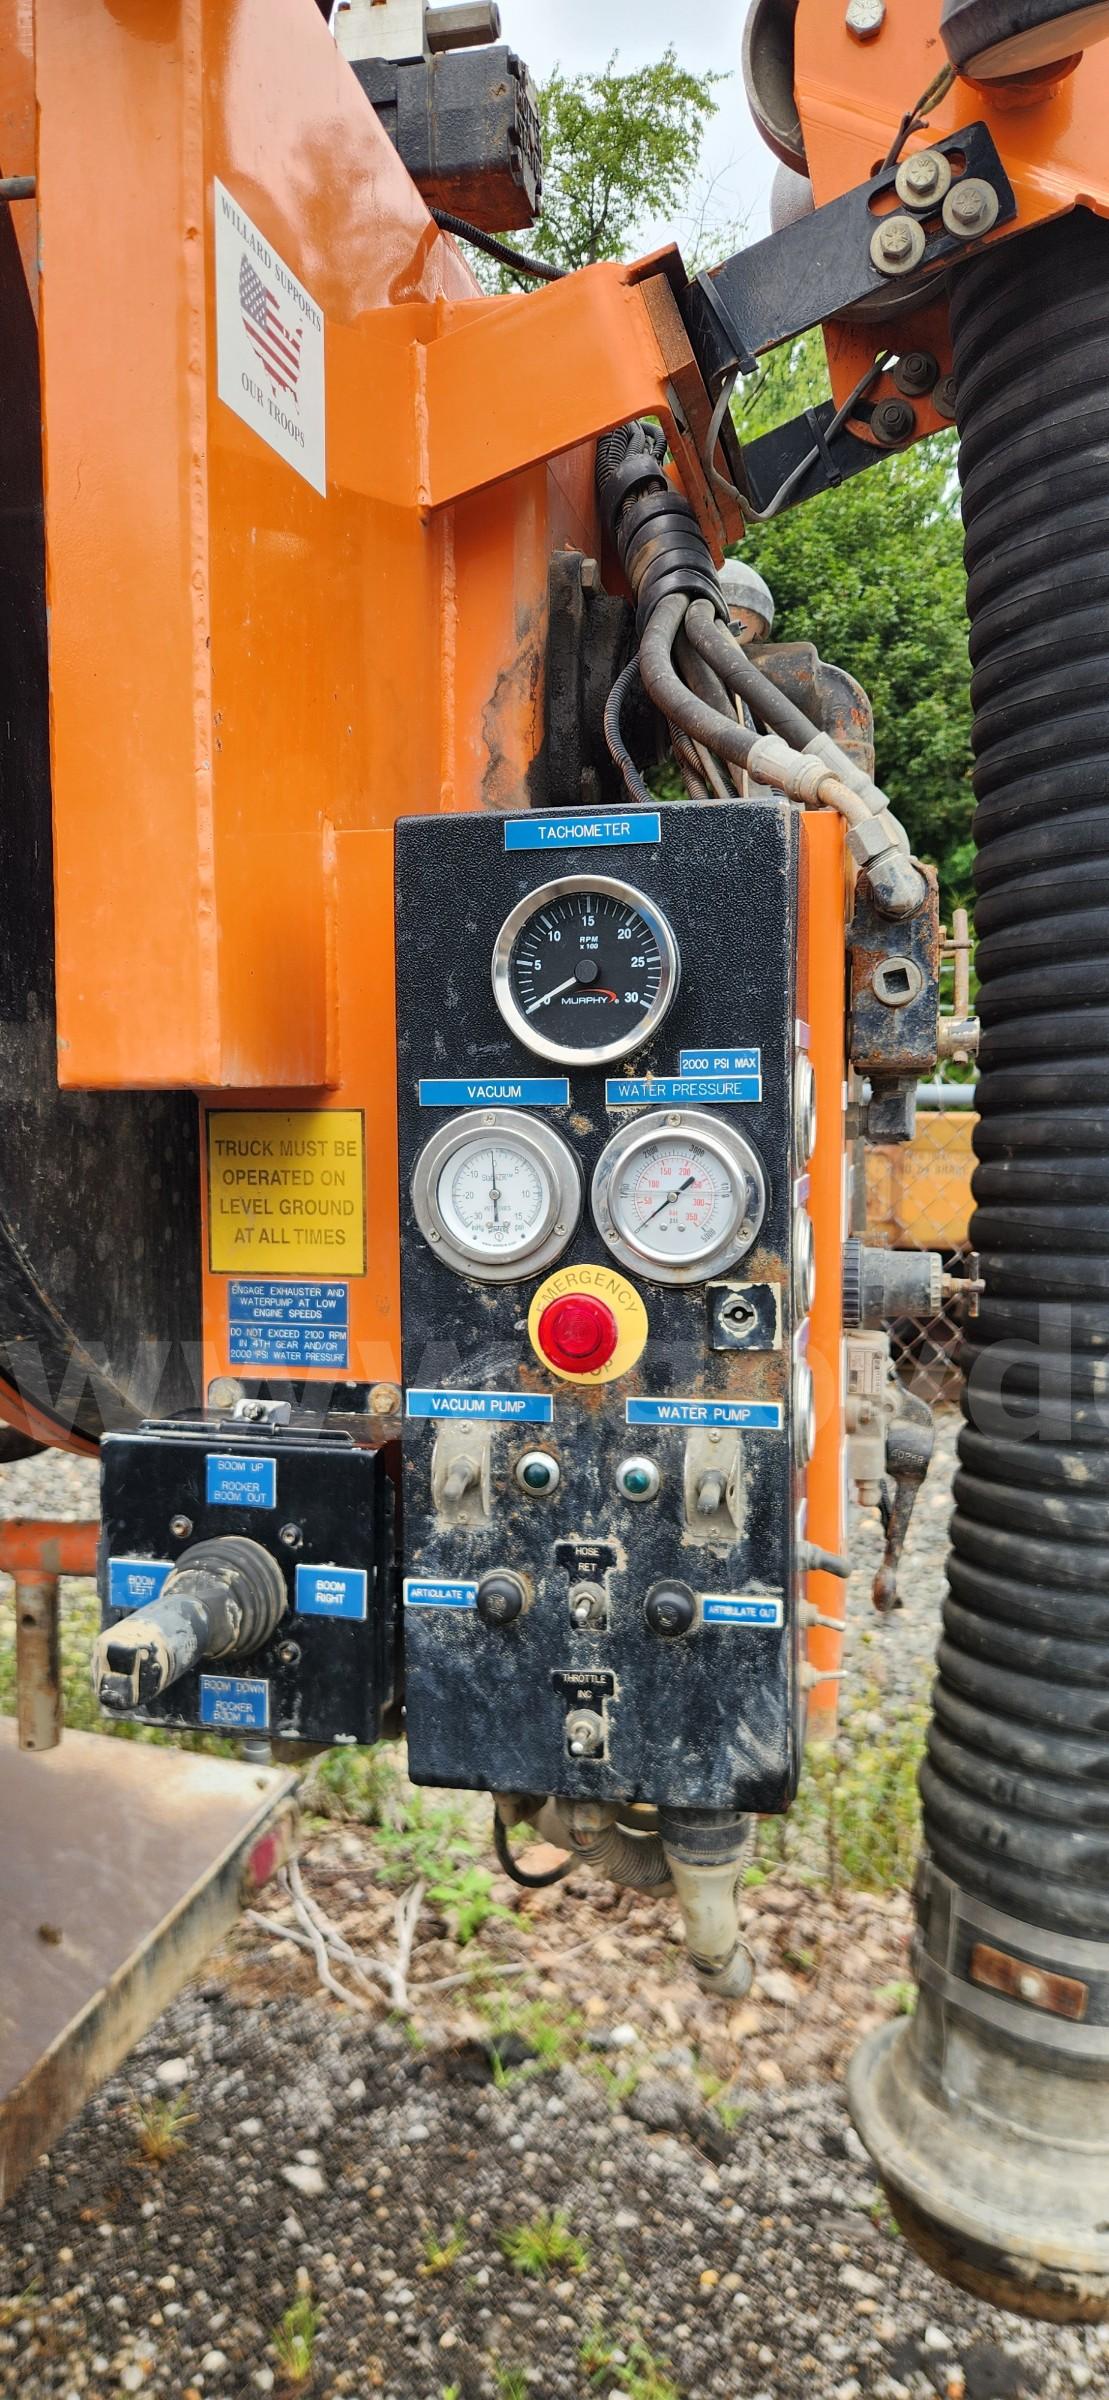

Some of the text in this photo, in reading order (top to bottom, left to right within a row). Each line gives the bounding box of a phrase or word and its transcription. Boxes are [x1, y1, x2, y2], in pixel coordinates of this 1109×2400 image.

[221, 196, 322, 332] WILLARD SUPPORTS
[241, 372, 306, 449] OUR TROOPS
[538, 822, 631, 840] TACHOMETER
[581, 915, 595, 927] 15
[547, 930, 561, 942] 10
[617, 928, 632, 940] 20
[534, 959, 542, 971] 5
[631, 956, 645, 968] 25
[624, 991, 639, 1003] 30
[682, 1057, 756, 1070] 2000 PSI MAX
[467, 1085, 522, 1098] VACUUM
[618, 1082, 742, 1097] WATER PRESSURE
[214, 1140, 357, 1157] TRUCK MUST BE
[642, 1146, 659, 1159] 2000
[688, 1144, 705, 1157] 3000
[660, 1167, 672, 1175] 150
[678, 1167, 691, 1175] 200
[222, 1169, 346, 1186] OPERATED ON
[648, 1180, 660, 1188] 100
[521, 1190, 530, 1198] 10
[219, 1198, 354, 1216] LEVEL GROUND
[643, 1197, 652, 1205] 50
[692, 1198, 705, 1207] 300
[686, 1212, 698, 1221] 350
[234, 1228, 346, 1245] AT ALL TIMES
[231, 1285, 345, 1298] ENGAGE EXHAUSTER AND
[536, 1270, 638, 1314] EMERGENCY
[240, 1297, 337, 1308] WATERPUMP AT LOW
[253, 1309, 322, 1319] ENGINE SPEEDS
[230, 1327, 347, 1340] DO NOT EXCEED 2100 RPM
[239, 1338, 338, 1351] IN 4TH GEAR AND/OR
[230, 1349, 345, 1362] 2000 PSI WATER PRESSURE
[432, 1398, 526, 1413] VACUUM PUMP
[657, 1406, 751, 1421] WATER PUMP
[217, 1460, 264, 1472] BOOM UP
[221, 1480, 260, 1492] ROCKER
[213, 1490, 266, 1503] BOOM OUT
[575, 1547, 600, 1557] HOSE
[578, 1562, 596, 1572] RET
[127, 1574, 156, 1585] BOOM
[129, 1585, 154, 1596] LEFT
[316, 1580, 346, 1592] BOOM
[315, 1592, 345, 1605] RIGHT
[759, 1608, 776, 1618] OUT
[562, 1674, 607, 1683] THROTTLE
[203, 1679, 266, 1693] BOOM DOWN
[577, 1690, 593, 1698] INC
[215, 1701, 253, 1712] ROCKER
[212, 1711, 255, 1723] BOOM IN
